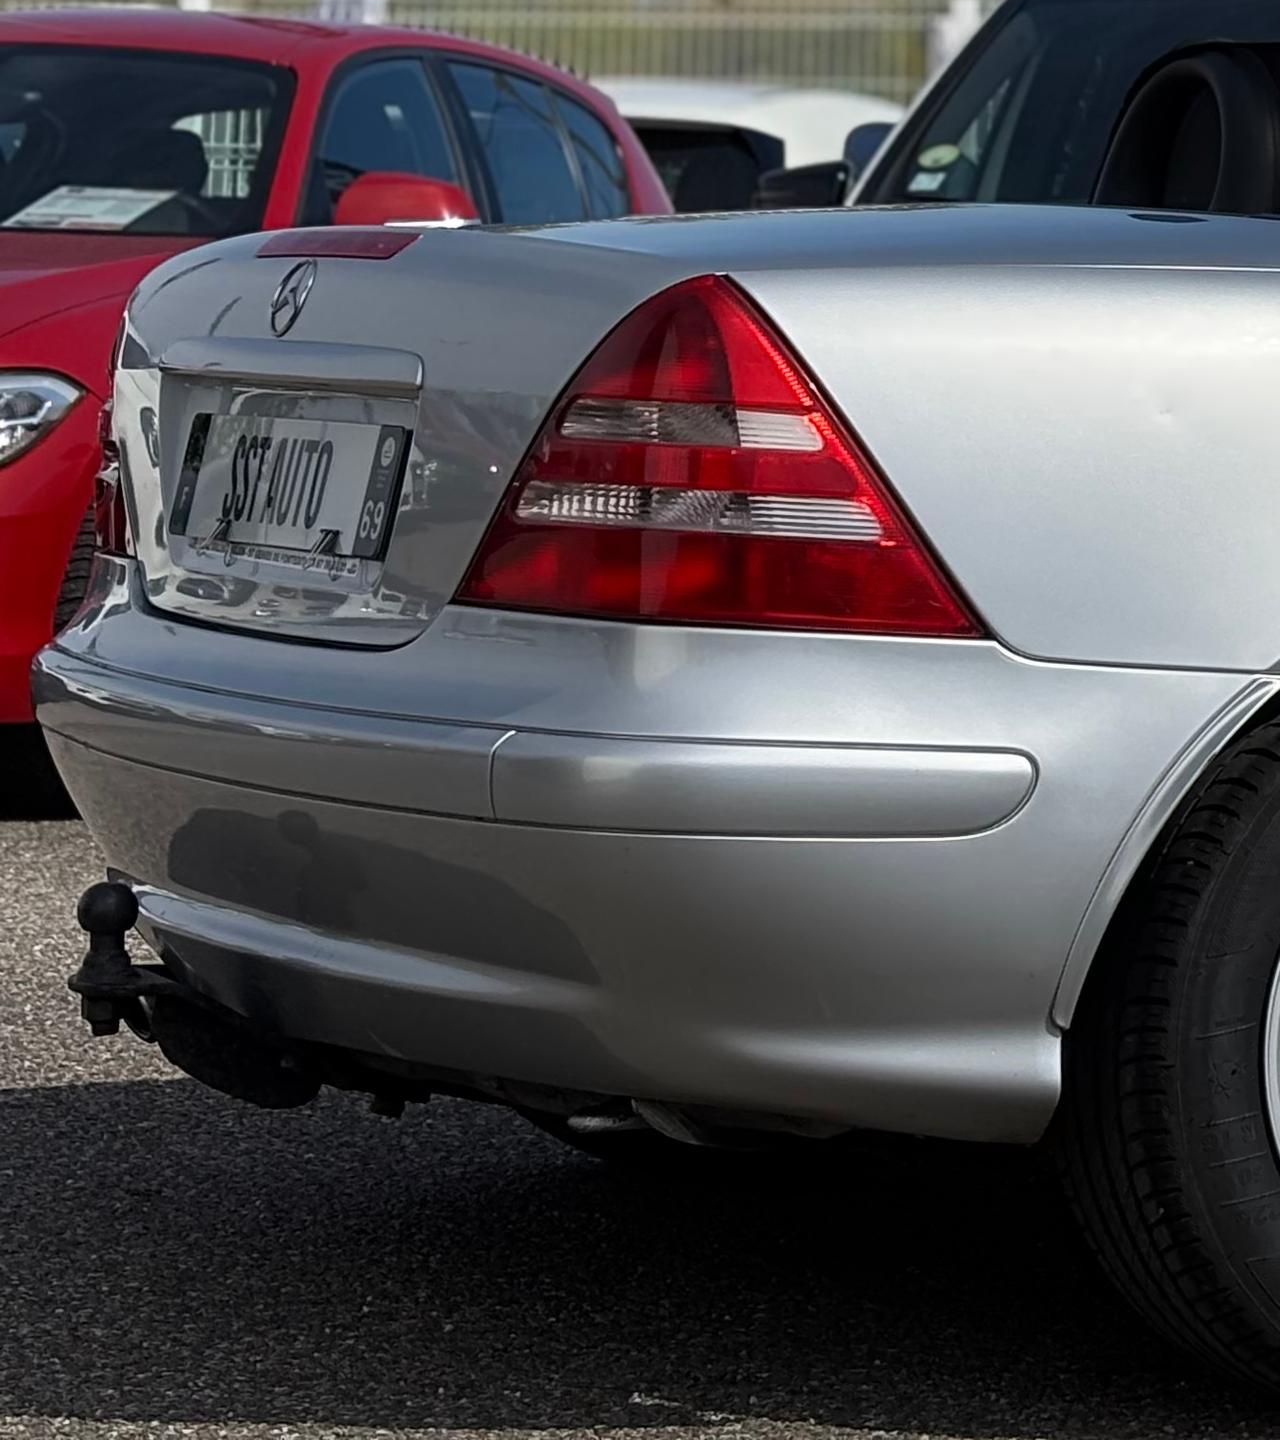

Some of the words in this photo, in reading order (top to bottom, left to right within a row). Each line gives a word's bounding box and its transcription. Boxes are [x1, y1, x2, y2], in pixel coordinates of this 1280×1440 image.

[221, 433, 273, 523] SST
[259, 436, 333, 530] AUTO
[360, 499, 385, 539] 69
